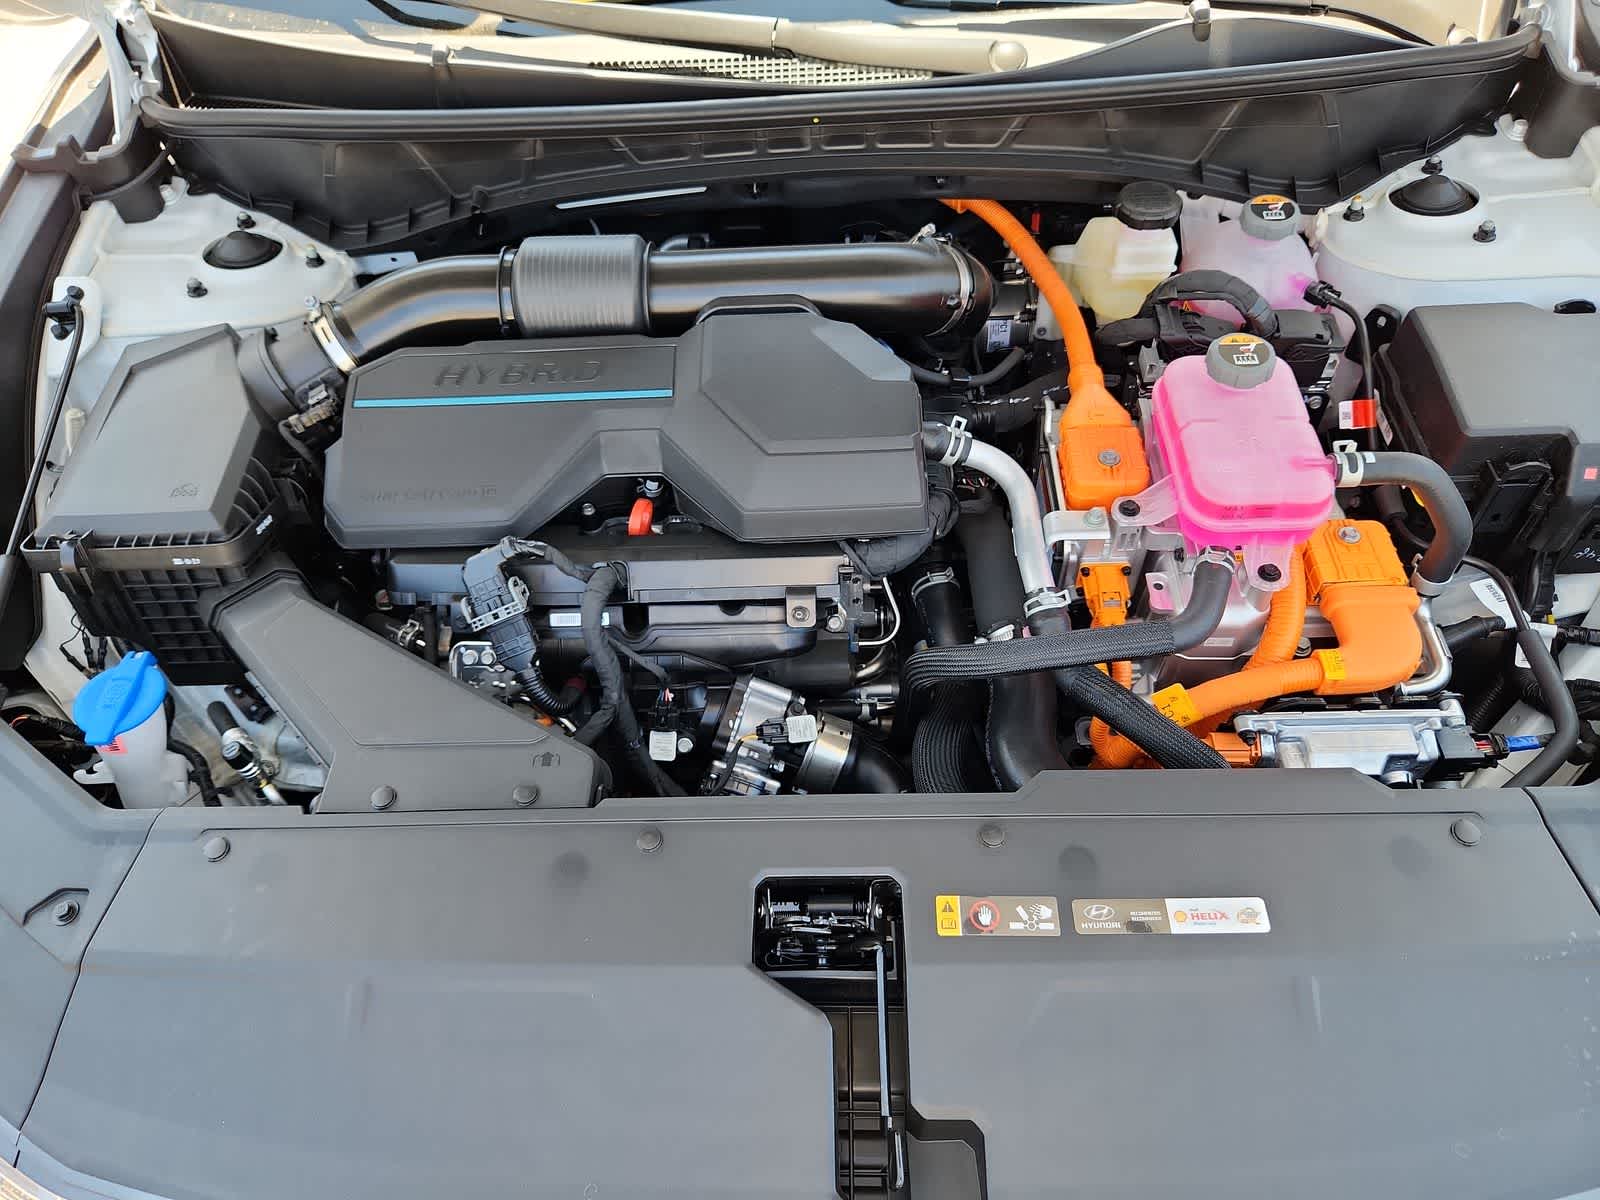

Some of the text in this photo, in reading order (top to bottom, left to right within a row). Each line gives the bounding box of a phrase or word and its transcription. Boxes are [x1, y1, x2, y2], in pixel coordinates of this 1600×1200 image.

[433, 360, 603, 388] HYBRID
[1190, 911, 1230, 921] HELIX
[1081, 921, 1121, 929] HYUNDAI
